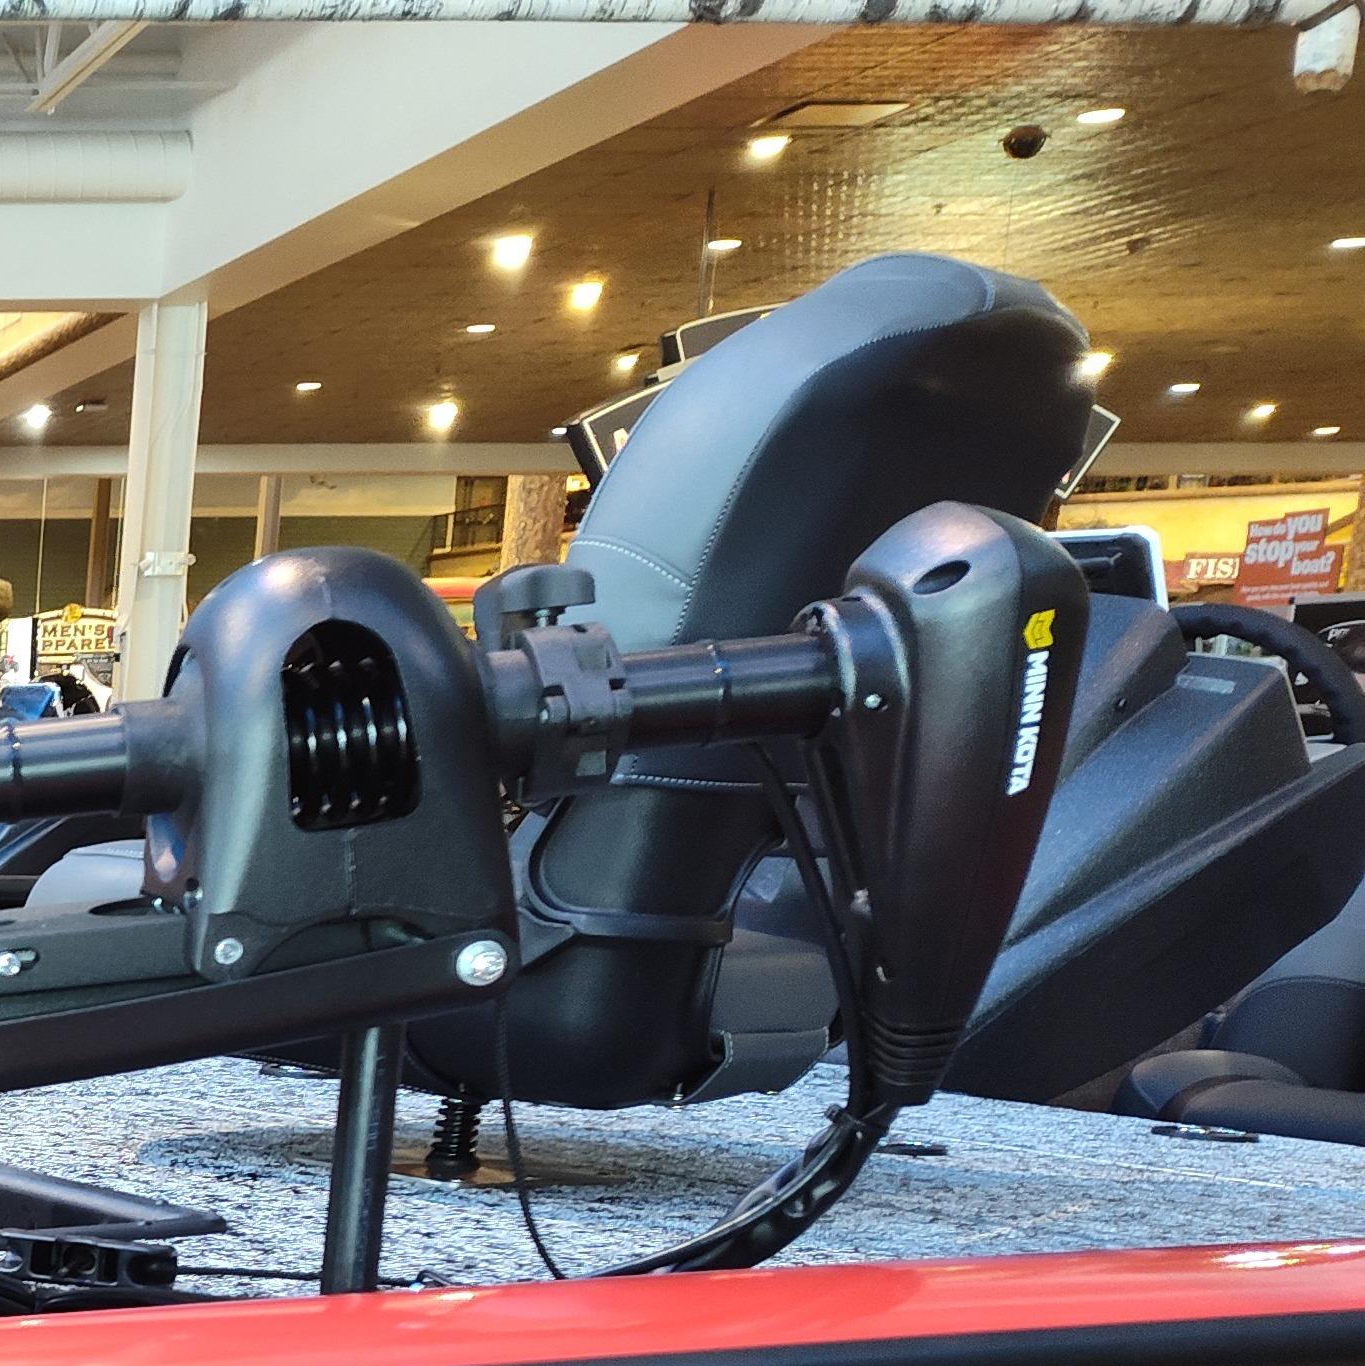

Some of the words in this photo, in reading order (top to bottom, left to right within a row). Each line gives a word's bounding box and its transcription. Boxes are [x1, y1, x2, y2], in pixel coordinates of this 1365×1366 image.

[1286, 514, 1324, 539] you
[1243, 538, 1294, 568] stop
[1290, 551, 1336, 576] boat?
[41, 624, 105, 638] MEN'S
[41, 638, 116, 651] PPAREL
[1020, 650, 1050, 724] MINN
[1005, 725, 1041, 797] KOTA
